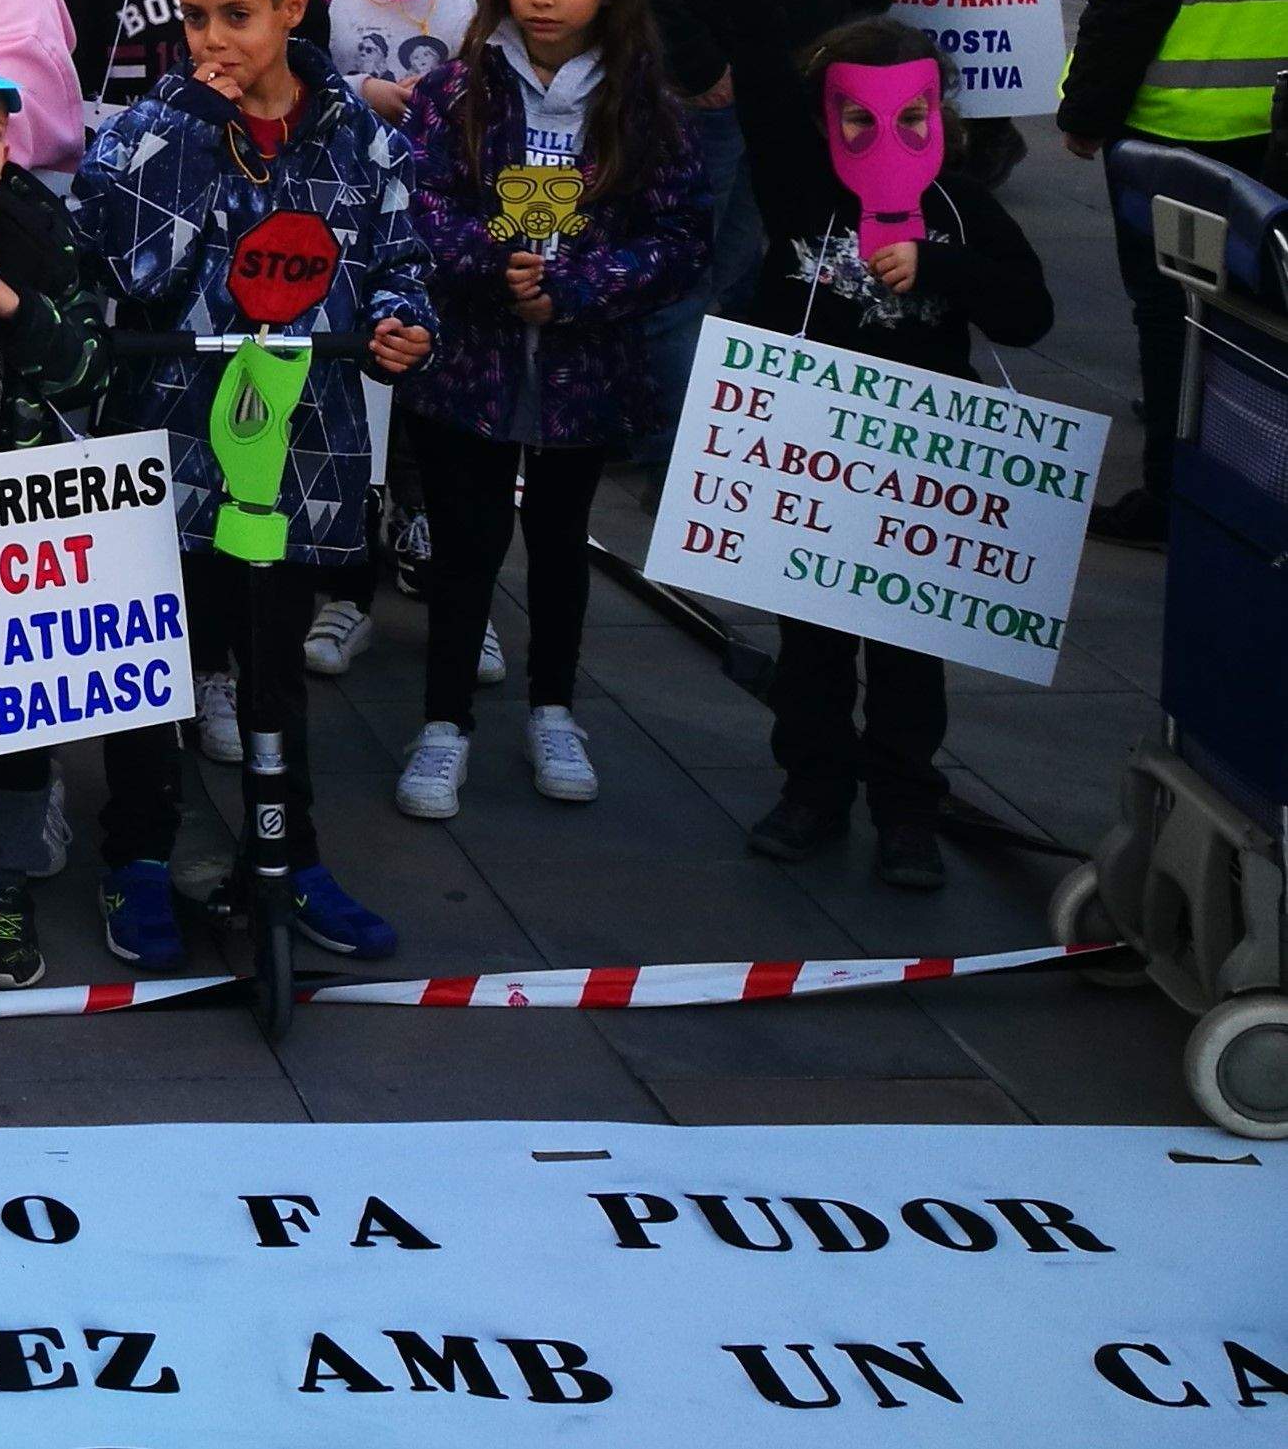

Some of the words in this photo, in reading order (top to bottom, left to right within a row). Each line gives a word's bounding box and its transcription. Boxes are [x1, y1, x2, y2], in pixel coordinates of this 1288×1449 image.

[237, 247, 328, 285] STOP
[711, 379, 776, 422] DE
[828, 406, 1092, 505] TERRITORI
[721, 335, 1082, 452] DEPARTAMENT
[691, 471, 751, 514] US
[771, 488, 833, 534] EL
[874, 514, 1038, 586] FOTEU
[704, 425, 1013, 531] L'ABOCADOR
[3, 592, 184, 667] ATURAR
[681, 519, 745, 566] DE
[783, 547, 1068, 652] SUPOSITORI
[238, 1193, 443, 1250] FA
[585, 1192, 1117, 1254] PUDOR
[297, 1329, 614, 1405] AMB
[721, 1341, 965, 1409] UN
